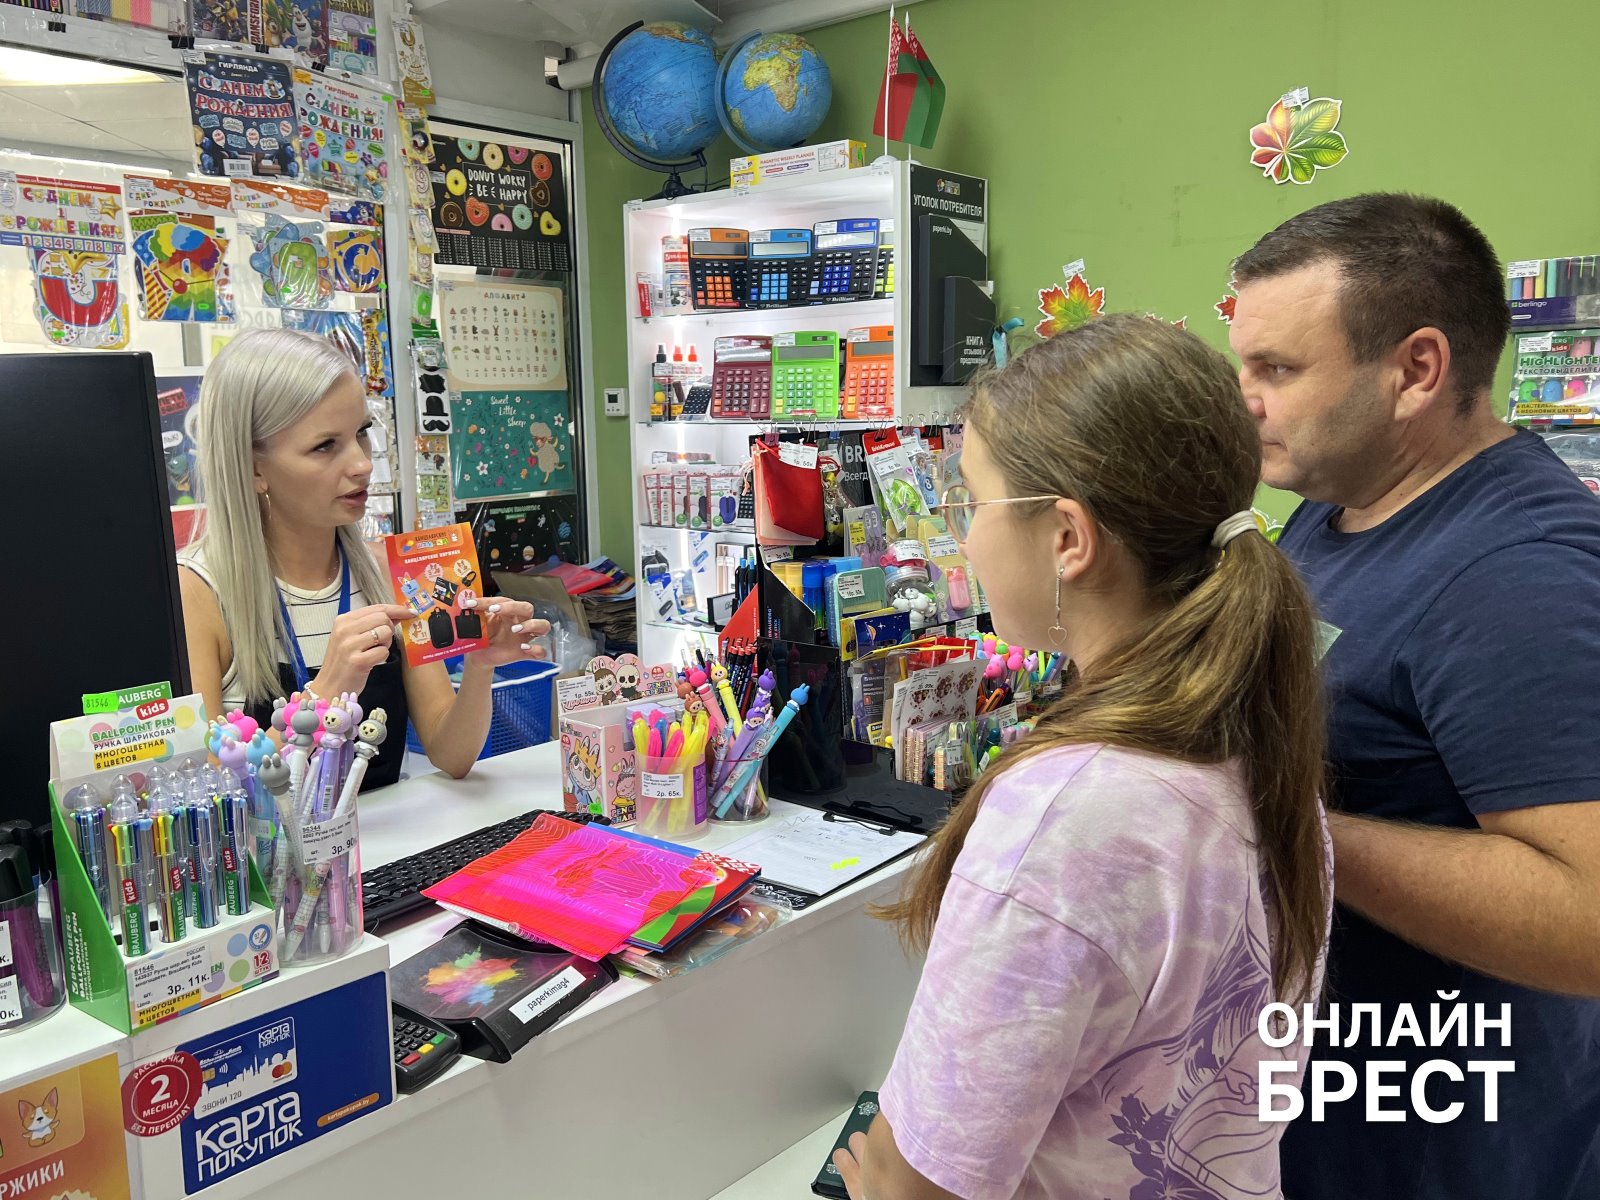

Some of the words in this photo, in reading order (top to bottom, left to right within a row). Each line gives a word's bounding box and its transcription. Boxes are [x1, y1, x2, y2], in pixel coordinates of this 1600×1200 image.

[218, 61, 259, 72] ГИРЛЯНДА
[220, 80, 266, 97] ДНЕМ
[324, 85, 359, 99] ГИРЛЯНДА
[321, 99, 359, 120] ДНЕМ
[468, 168, 495, 184] DONUT
[498, 173, 526, 188] WORRY
[476, 184, 489, 197] BE
[499, 188, 528, 204] HAPPY
[913, 193, 939, 209] УГОЛОК
[939, 199, 983, 218] ПОТРЕБИТЕЛЯ
[966, 335, 984, 345] КНИГА
[1520, 354, 1600, 367] HIGHLIGHTE
[490, 394, 509, 405] Sweet
[499, 405, 517, 416] Little
[507, 416, 527, 428] Sheep
[925, 478, 933, 491] 8
[86, 698, 109, 708] 81546
[139, 702, 166, 718] kids
[92, 721, 152, 742] BALLPOINT
[154, 716, 176, 729] PEN
[93, 740, 122, 751] РУЧКА
[123, 727, 176, 744] ШАРИКОВАЯ
[95, 738, 165, 760] МНОГОЦВЕТНАЯ
[104, 754, 137, 768] ЦВЕТОВ
[611, 805, 636, 817] PENCI
[225, 850, 234, 869] kids
[332, 845, 345, 855] 3р.
[173, 869, 181, 889] kids
[125, 881, 136, 901] kids
[129, 912, 140, 955] BRAUBERG
[66, 914, 77, 980] BRAUBERG
[253, 952, 269, 967] 12
[254, 965, 270, 975] ШТУК
[167, 984, 185, 996] 3р.
[188, 973, 210, 987] 11к.
[527, 976, 570, 1011] paperkimag4
[139, 988, 200, 1017] МНОГОЦВЕТНАЯ
[146, 1006, 175, 1022] ЦВЕТОВ
[133, 1054, 185, 1080] РАССРОЧКА
[150, 1074, 171, 1105] 2
[142, 1099, 179, 1118] МЕСЯЦА
[201, 1096, 228, 1112] ЗВОНИ
[229, 1090, 243, 1101] 120
[131, 1122, 146, 1134] БЕЗ
[148, 1104, 191, 1135] ПЕРЕПЛАТ
